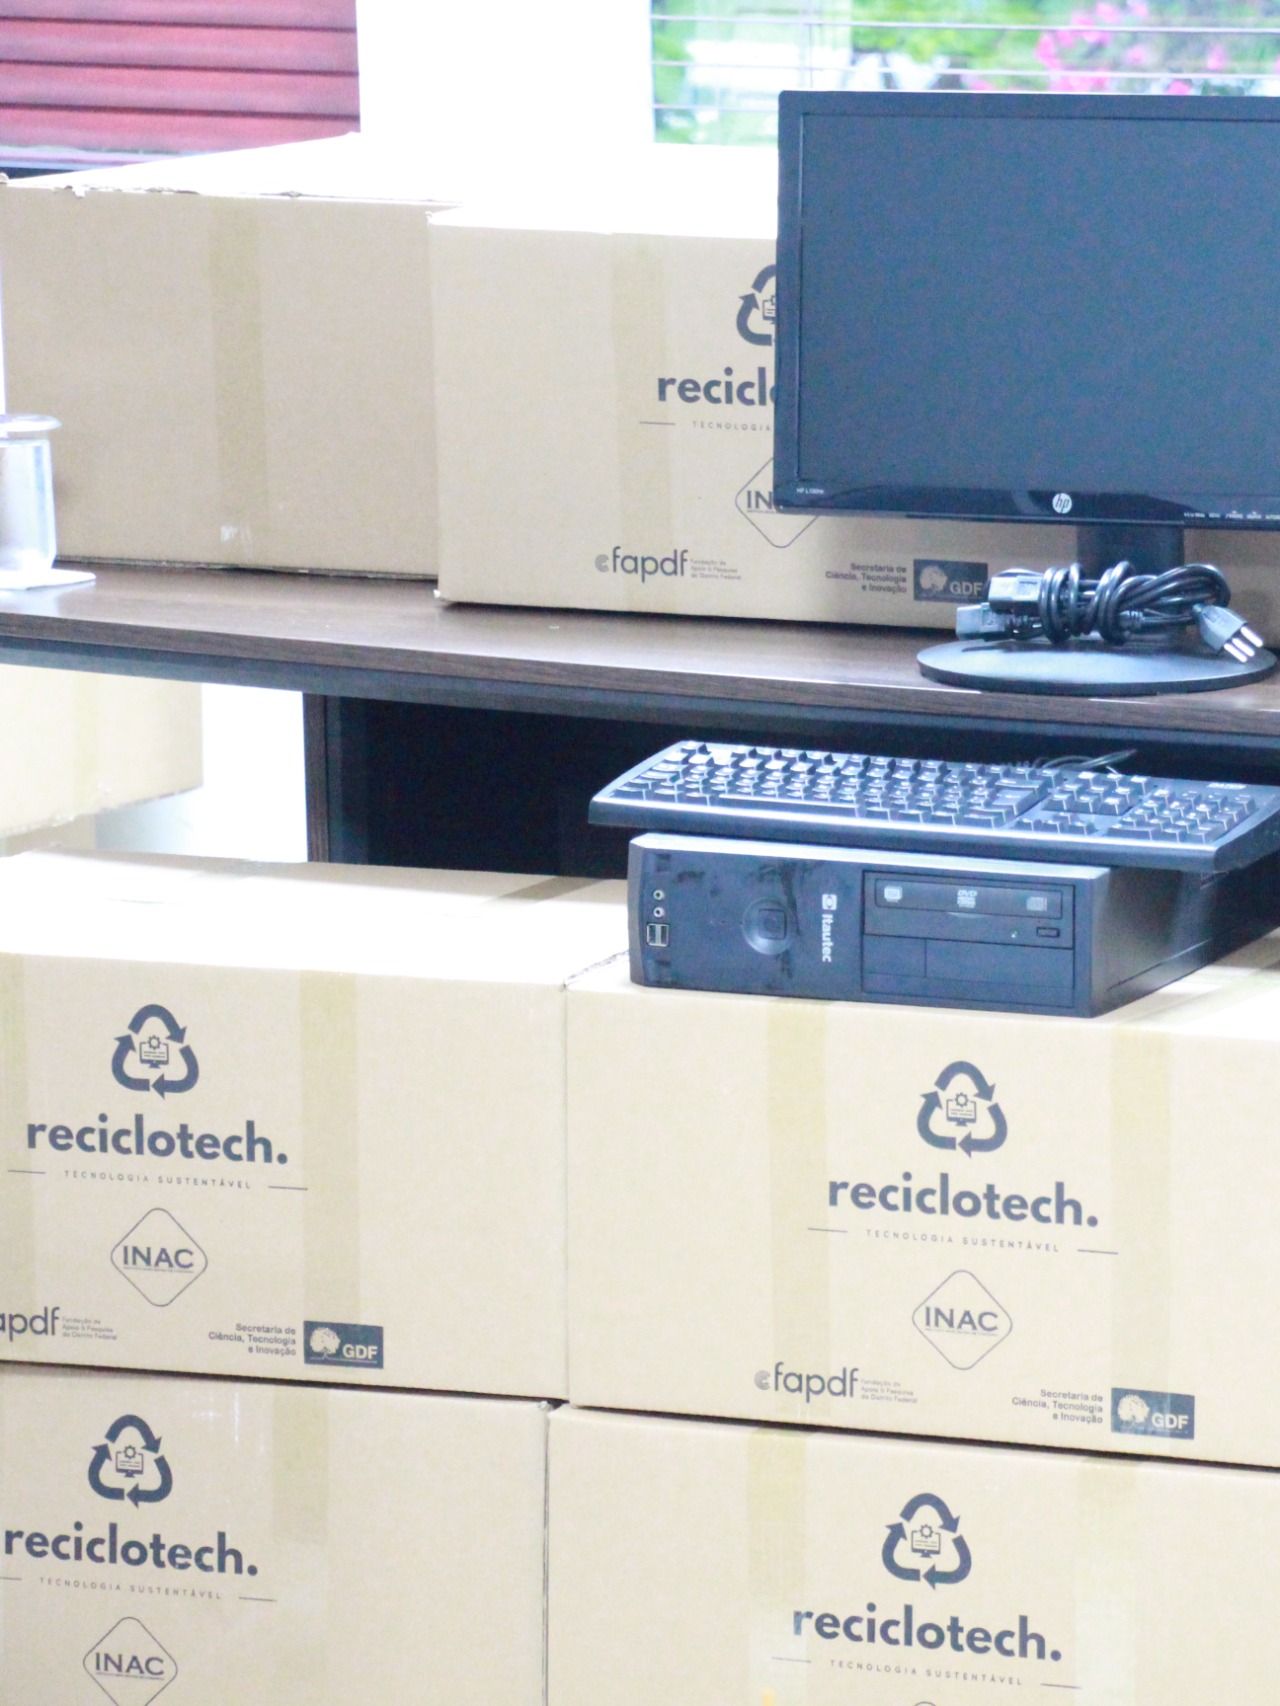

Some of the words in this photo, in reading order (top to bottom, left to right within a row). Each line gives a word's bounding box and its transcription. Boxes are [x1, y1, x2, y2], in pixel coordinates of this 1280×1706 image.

[658, 366, 776, 406] recicl
[692, 420, 771, 432] TECNOLOGIA
[1053, 493, 1072, 514] hp
[613, 546, 688, 583] fapdf
[850, 562, 895, 574] Secretaria
[860, 572, 907, 586] Tecnologia
[949, 580, 983, 597] GDF
[822, 913, 834, 963] Itautec
[27, 1113, 287, 1164] reciclotech.
[63, 1169, 149, 1183] TECNOLOGIA
[157, 1175, 251, 1190] SUSTENTÁVEL
[829, 1172, 1098, 1227] reciclotech.
[865, 1228, 954, 1244] TECNOLOGIA
[962, 1236, 1059, 1253] SUSTENTÁVEL
[123, 1245, 194, 1269] INAC
[0, 1307, 59, 1342] pdf
[235, 1322, 283, 1335] Secretaria
[283, 1326, 297, 1336] de
[925, 1306, 999, 1332] INAC
[207, 1331, 245, 1344] Ciência,
[247, 1333, 297, 1347] Tecnologia
[255, 1344, 297, 1357] Inovação
[342, 1343, 378, 1360] GDF
[775, 1362, 858, 1403] fapdf
[1011, 1396, 1050, 1410] Ciência,
[1051, 1400, 1104, 1416] Tecnologia
[1040, 1388, 1090, 1401] Secretaria
[1090, 1393, 1104, 1403] de
[1060, 1409, 1104, 1425] Inovação
[1150, 1411, 1189, 1431] GDF
[5, 1521, 257, 1576] reciclotech.
[39, 1576, 121, 1591] TECNOLOGIA
[129, 1584, 221, 1600] SUSTENTÁVEL
[794, 1602, 1061, 1661] reciclotech.
[95, 1651, 165, 1676] INAC
[830, 1659, 917, 1676] TECNOLOGIA
[925, 1668, 1022, 1686] SUSTENTÁVEL
